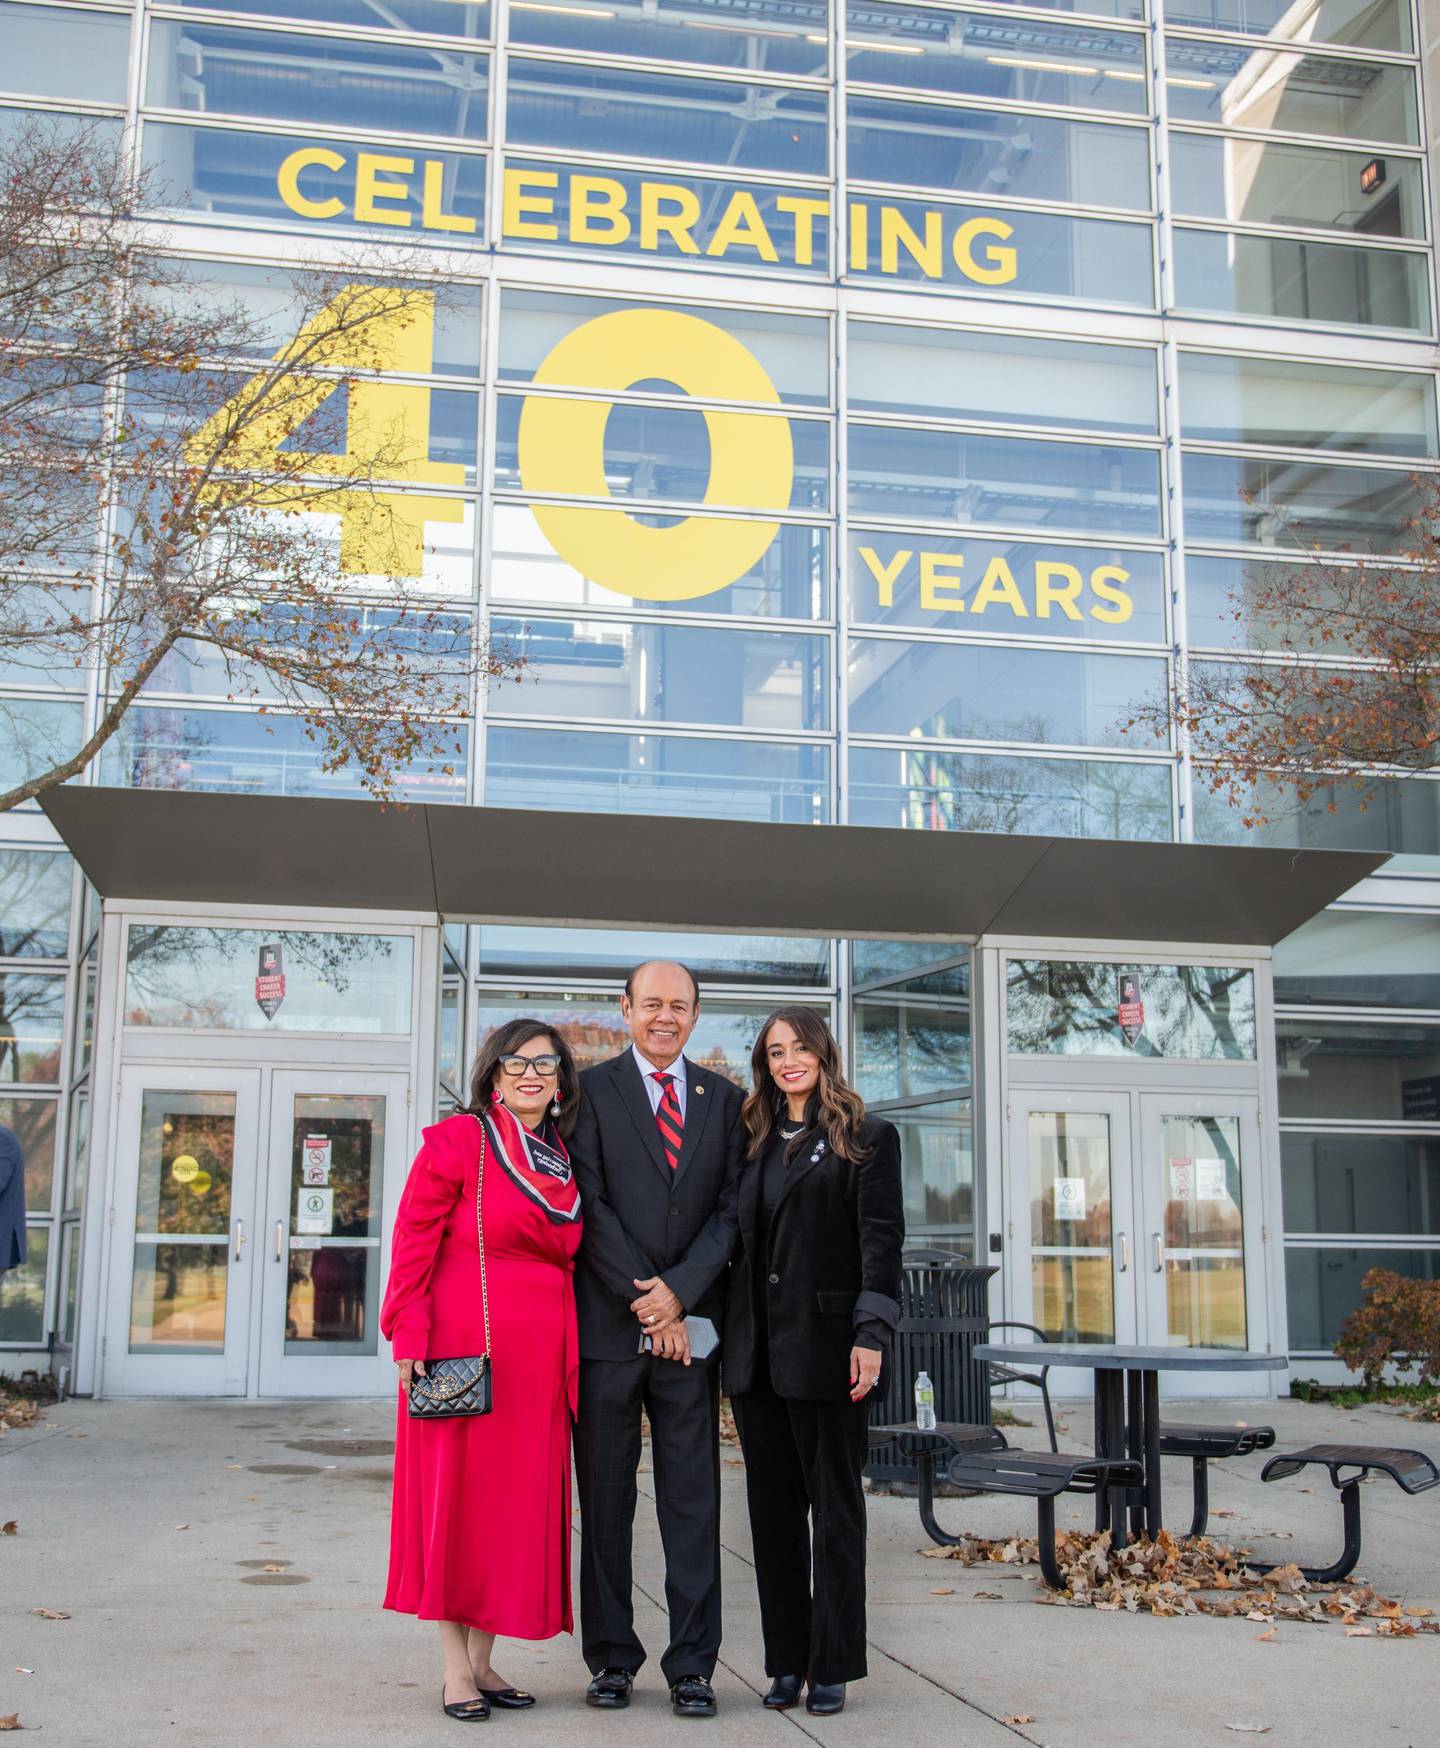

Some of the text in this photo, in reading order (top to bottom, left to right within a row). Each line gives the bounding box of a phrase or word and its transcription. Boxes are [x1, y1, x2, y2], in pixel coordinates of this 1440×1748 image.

[277, 147, 1018, 287] CELEBRATING
[184, 283, 1134, 624] 40 YEARS
[259, 990, 282, 999] SUCCESS
